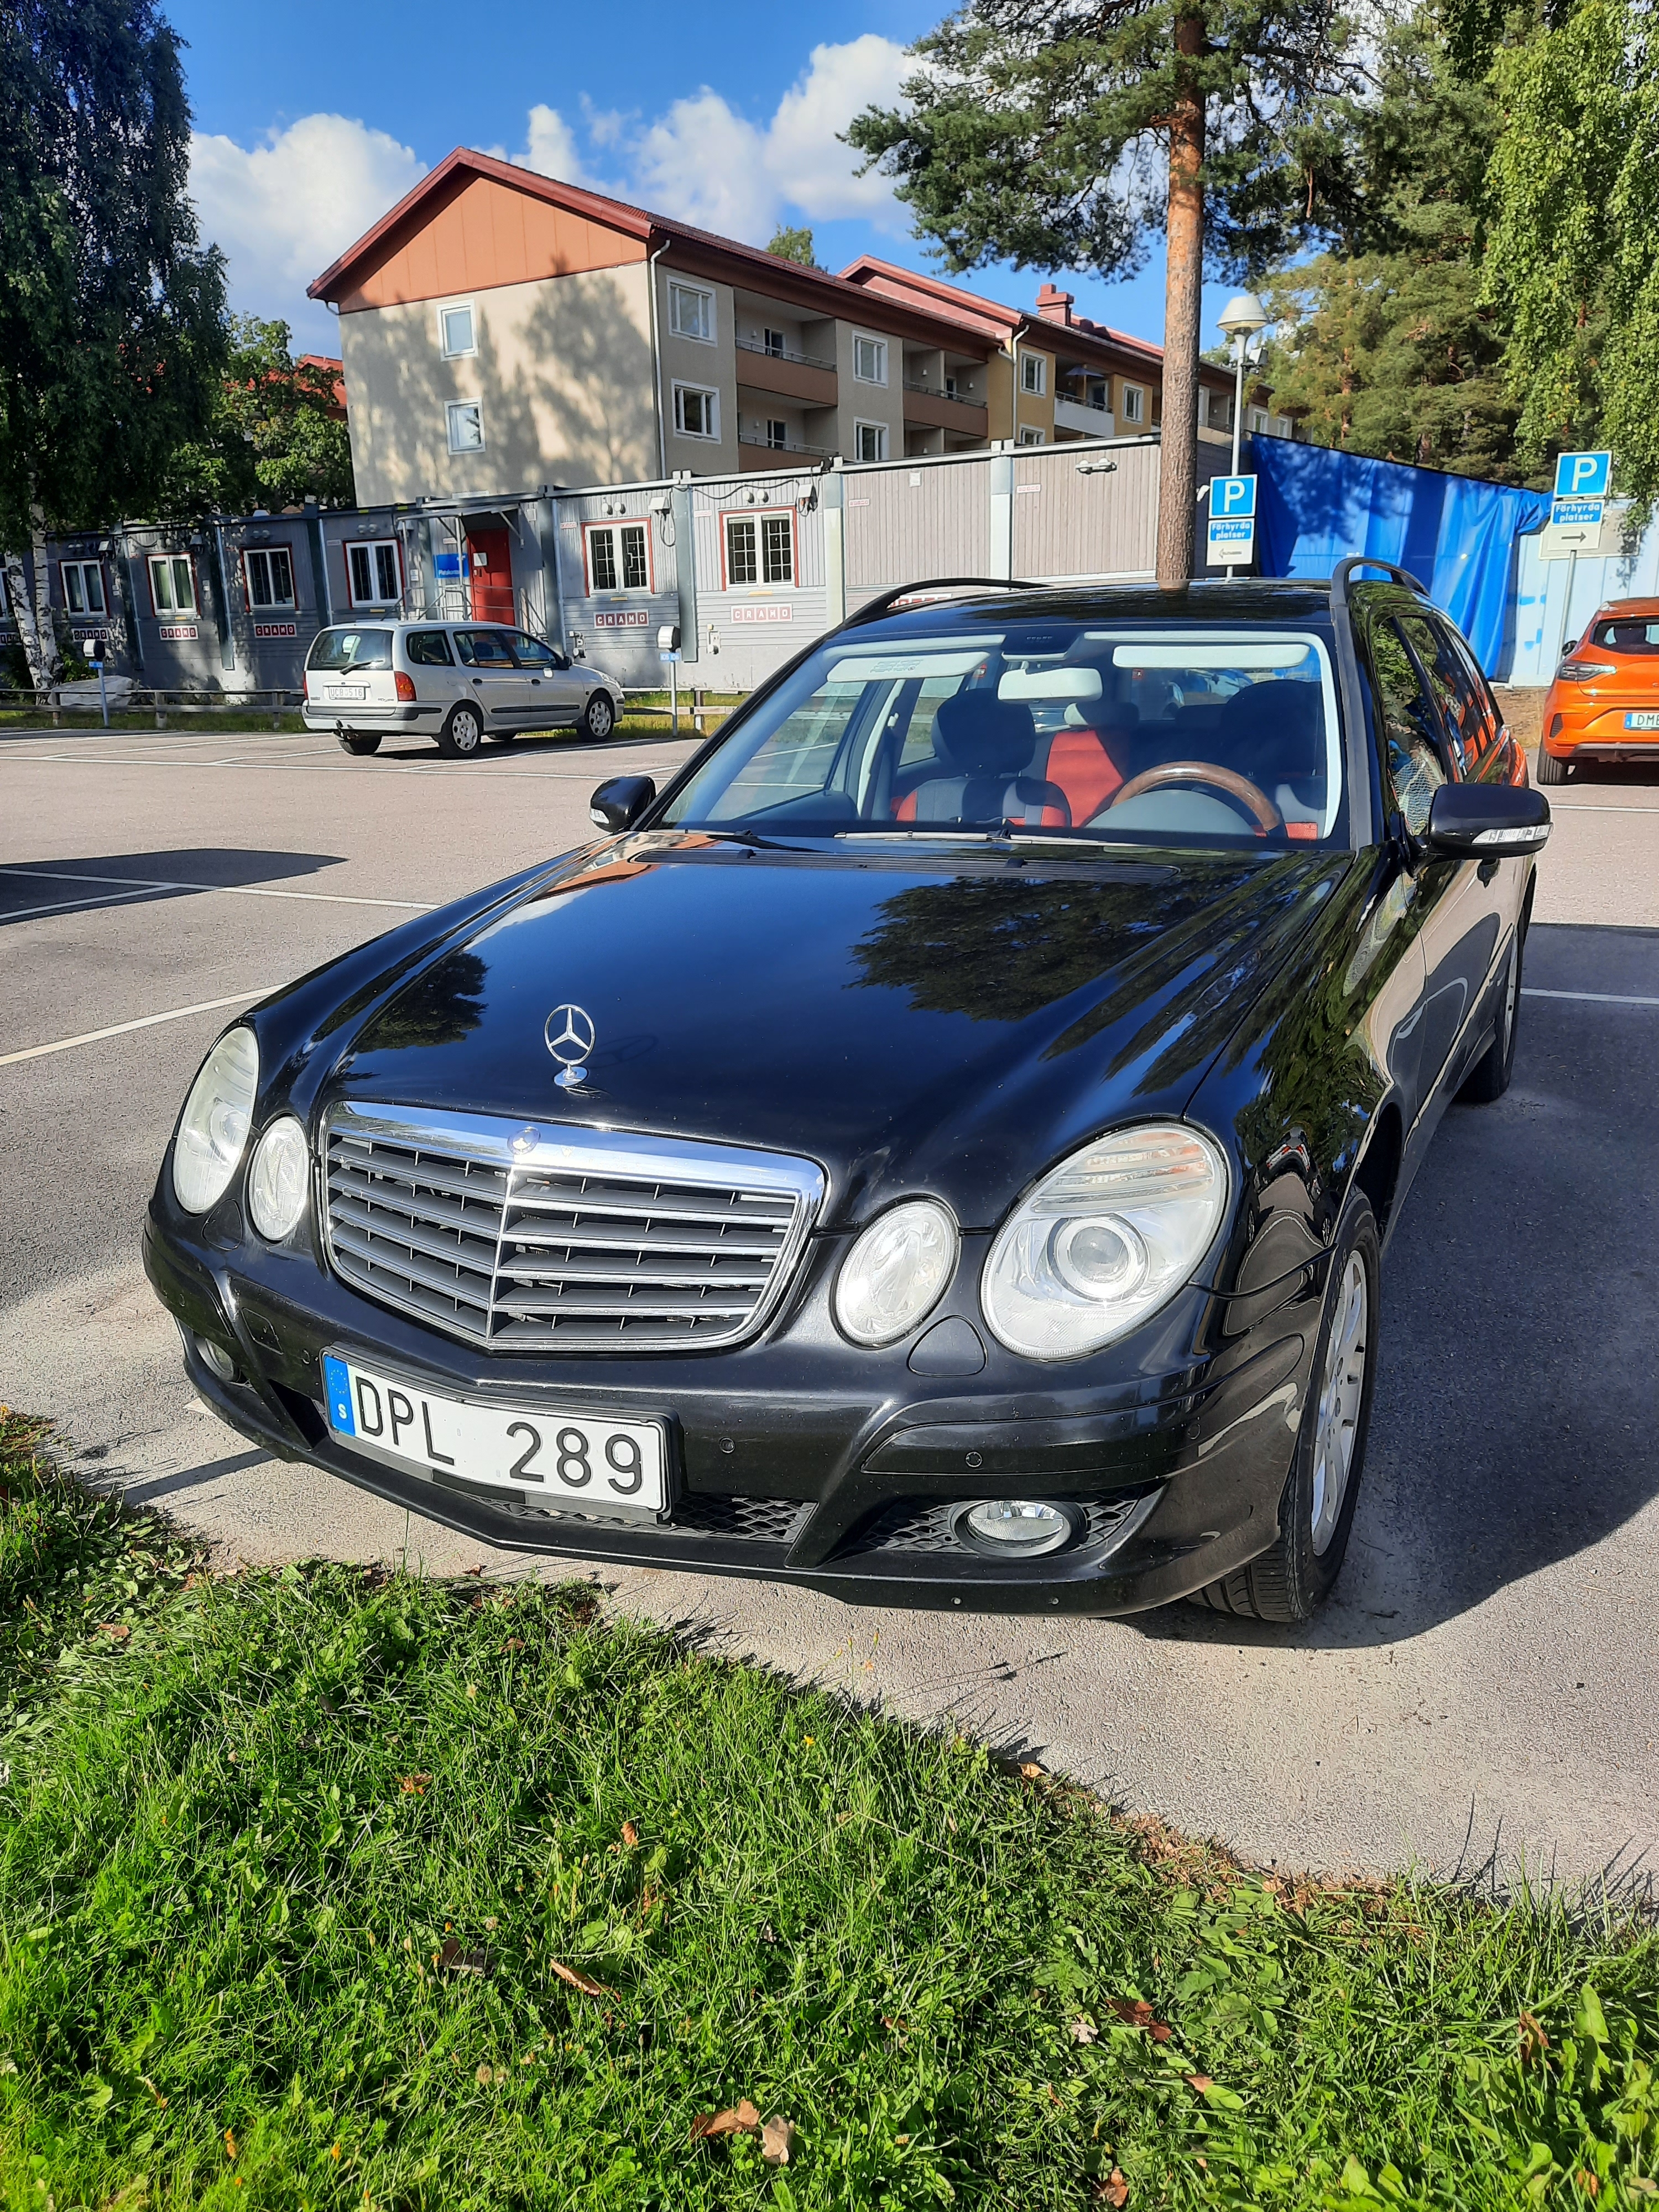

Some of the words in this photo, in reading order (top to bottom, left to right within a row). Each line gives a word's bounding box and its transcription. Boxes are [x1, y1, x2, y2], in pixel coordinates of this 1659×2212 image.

[1571, 457, 1598, 492] P
[1224, 480, 1245, 513] P
[1556, 503, 1600, 513] Förhyrda
[1559, 513, 1594, 523] platser
[1212, 521, 1250, 531] Förhyrda
[1216, 531, 1245, 541] platser
[734, 608, 789, 619] CRAMO
[597, 613, 646, 625] CRAMO
[161, 628, 196, 637] CRAMO
[257, 625, 294, 635] CRAMO
[330, 688, 343, 696] UCB
[348, 688, 363, 697] 516
[337, 1404, 347, 1420] S
[355, 1375, 455, 1466] DPL
[506, 1421, 643, 1495] 289
